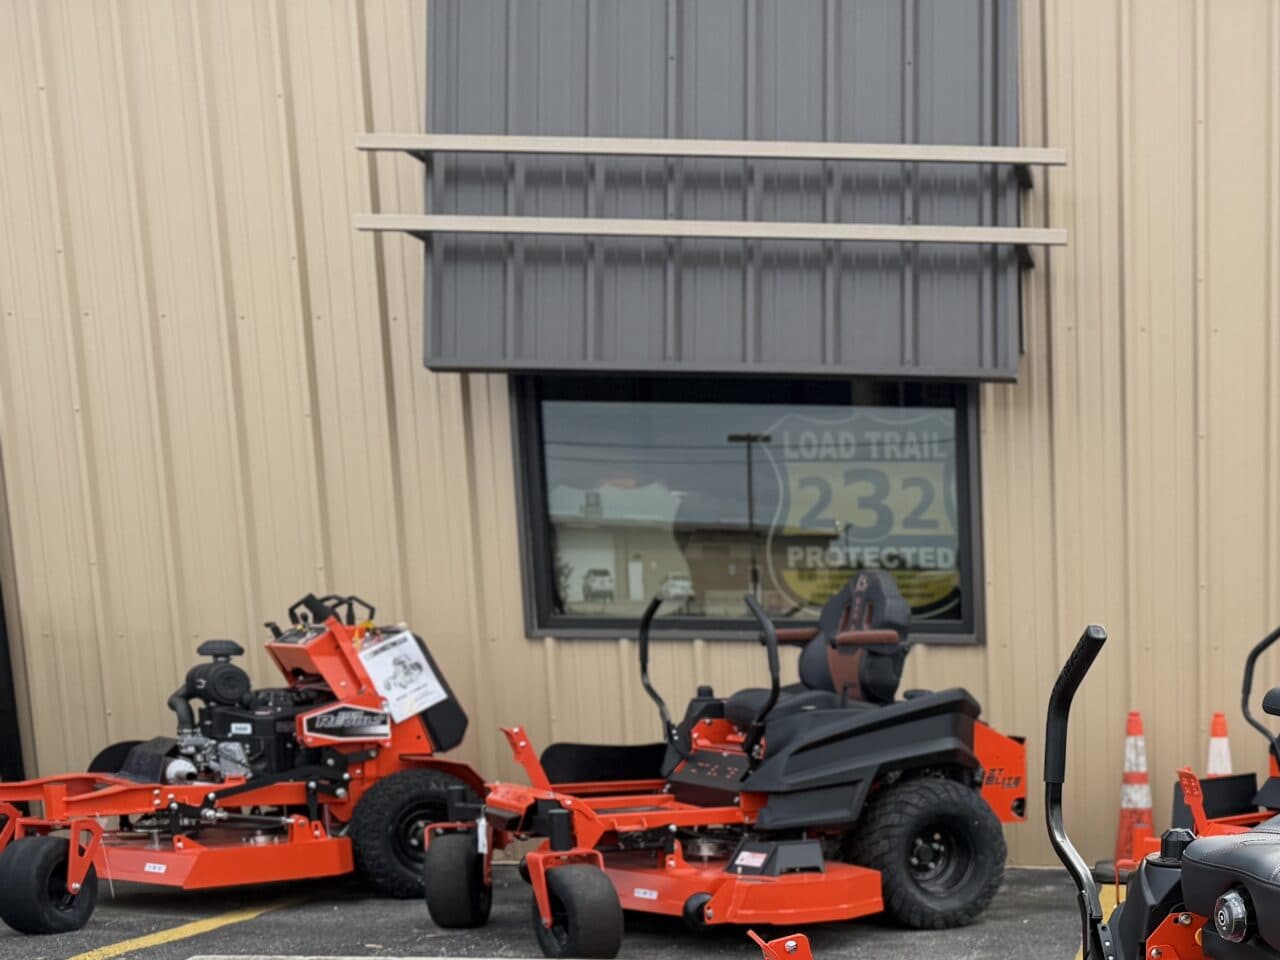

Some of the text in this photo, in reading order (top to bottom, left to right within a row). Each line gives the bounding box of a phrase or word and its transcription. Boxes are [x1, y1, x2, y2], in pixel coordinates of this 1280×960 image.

[783, 430, 948, 460] LOAD TRAIL
[797, 467, 940, 542] 232
[786, 546, 955, 569] PROTECTED
